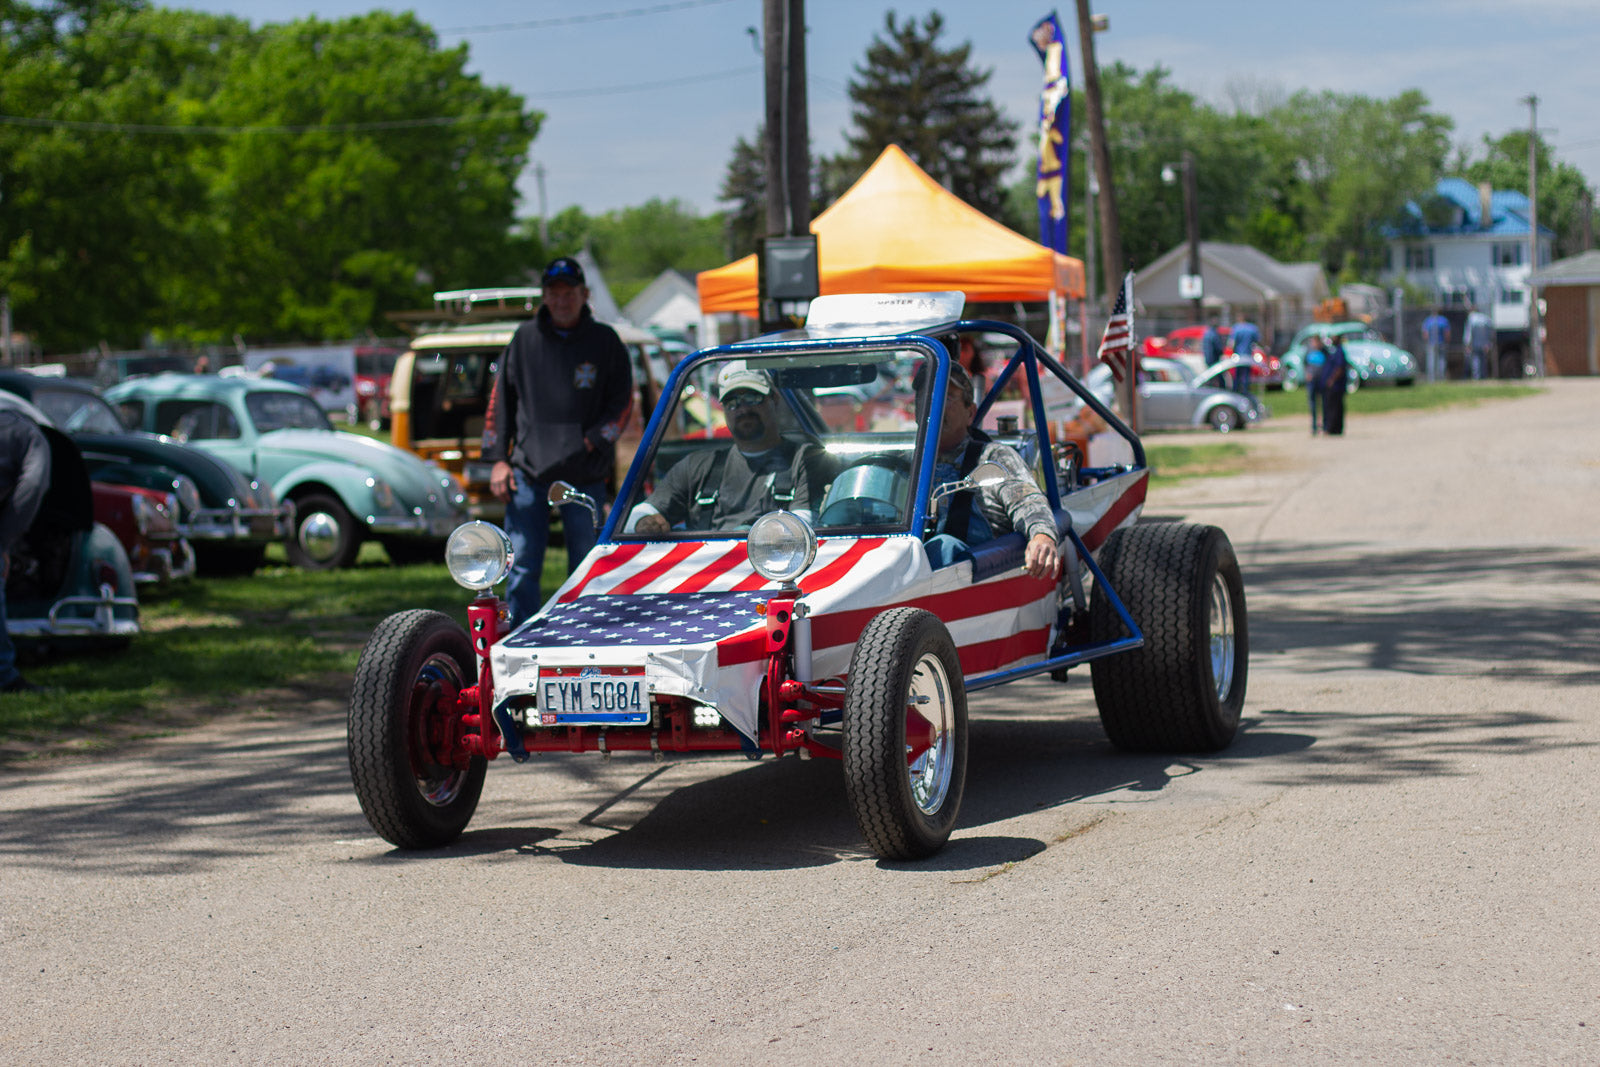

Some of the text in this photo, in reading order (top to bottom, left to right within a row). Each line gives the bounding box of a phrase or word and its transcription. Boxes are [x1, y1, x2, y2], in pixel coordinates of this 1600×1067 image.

[580, 666, 602, 677] Ohio
[545, 681, 641, 711] EYM 5084
